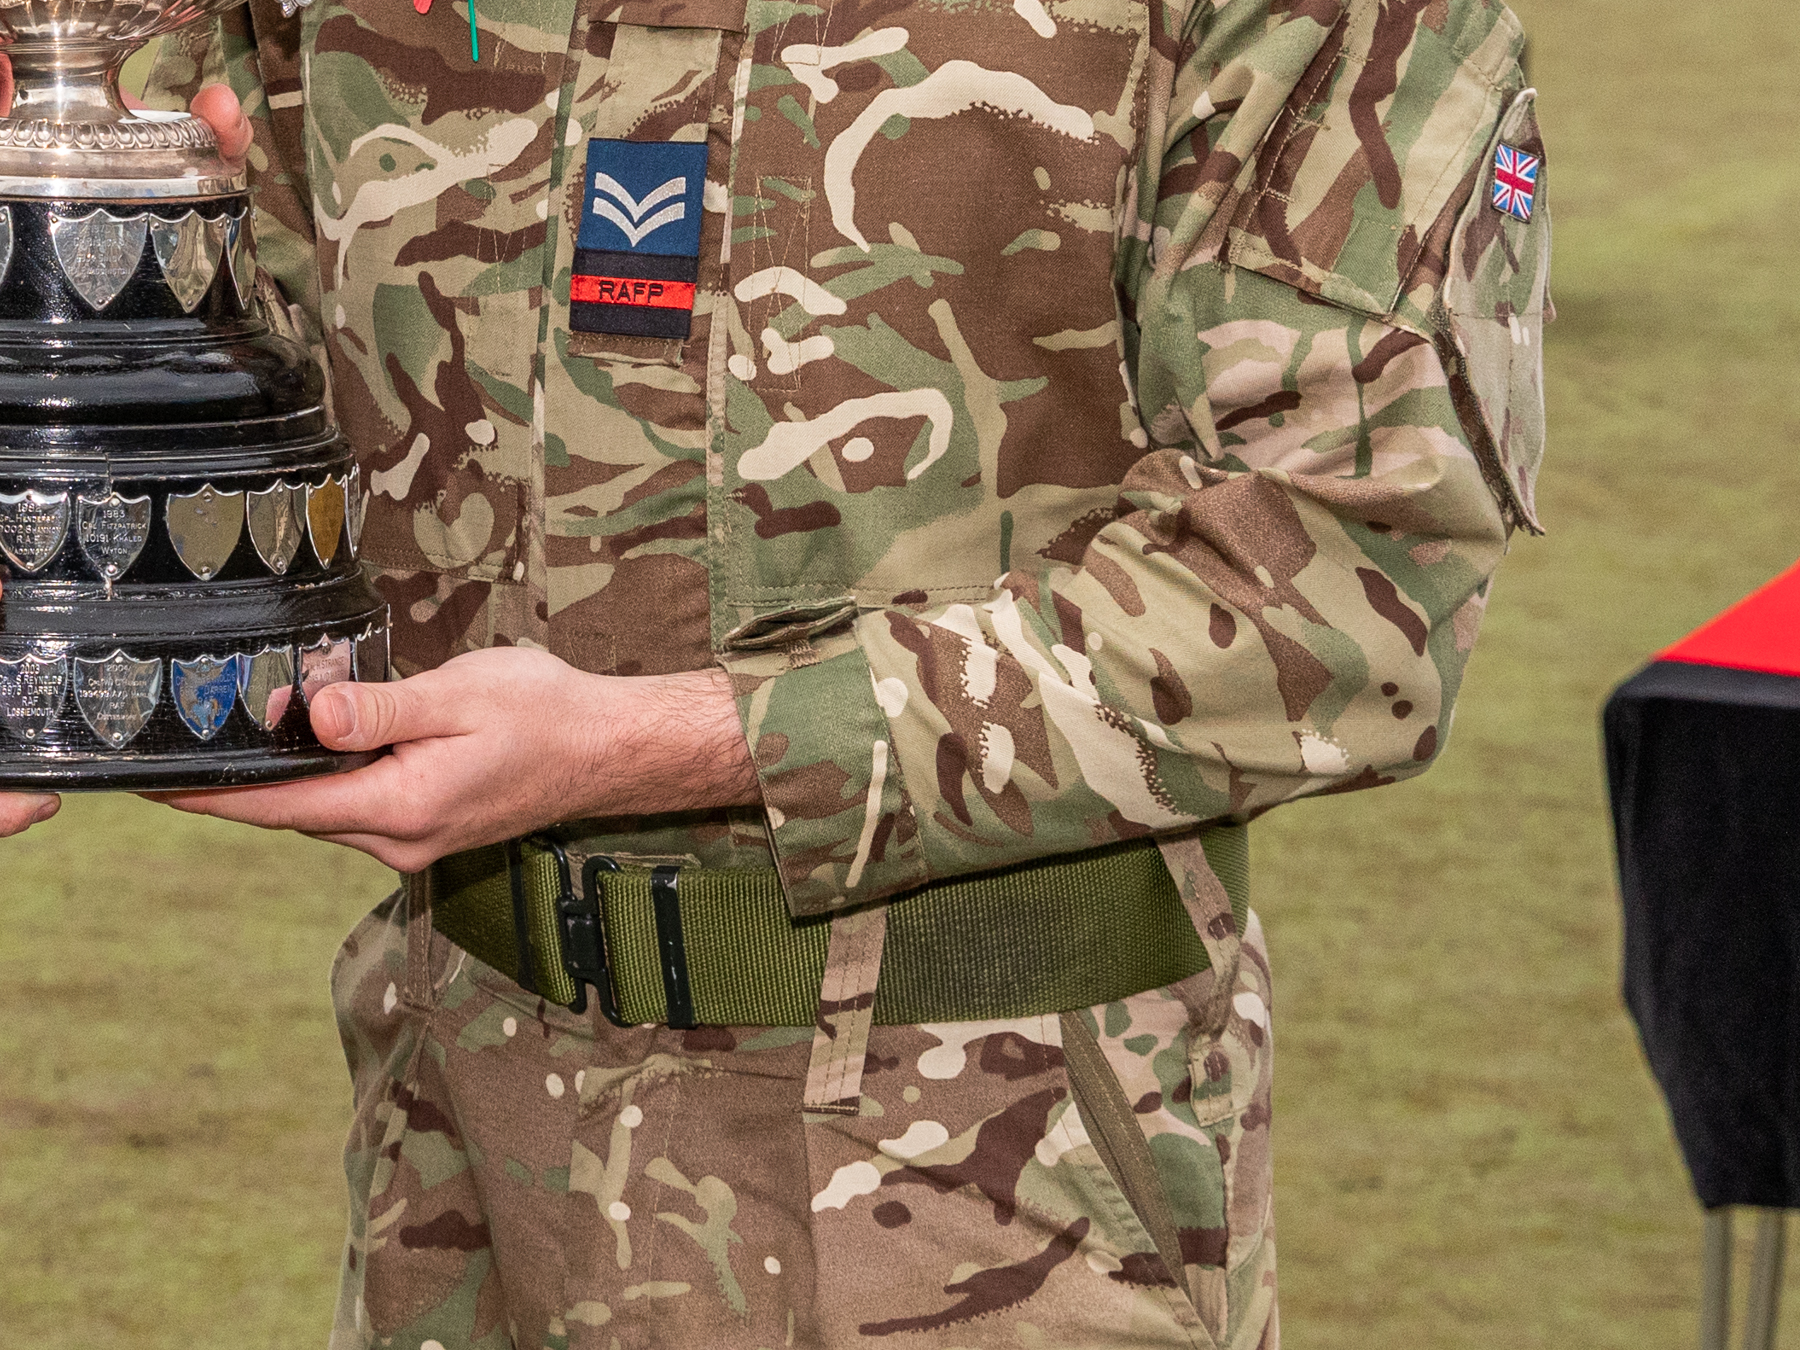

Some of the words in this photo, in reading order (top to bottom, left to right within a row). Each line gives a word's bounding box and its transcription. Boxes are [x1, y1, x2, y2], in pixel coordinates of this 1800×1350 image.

[598, 280, 664, 304] RAFP
[103, 510, 125, 518] 1983
[101, 521, 147, 530] FITZPATRICK
[86, 534, 109, 543] 10191
[113, 534, 142, 543] KHALED
[101, 546, 127, 555] WYTON
[20, 663, 40, 674] 2003
[27, 685, 59, 696] DARREN
[6, 707, 54, 717] LOSSIEMOUTH
